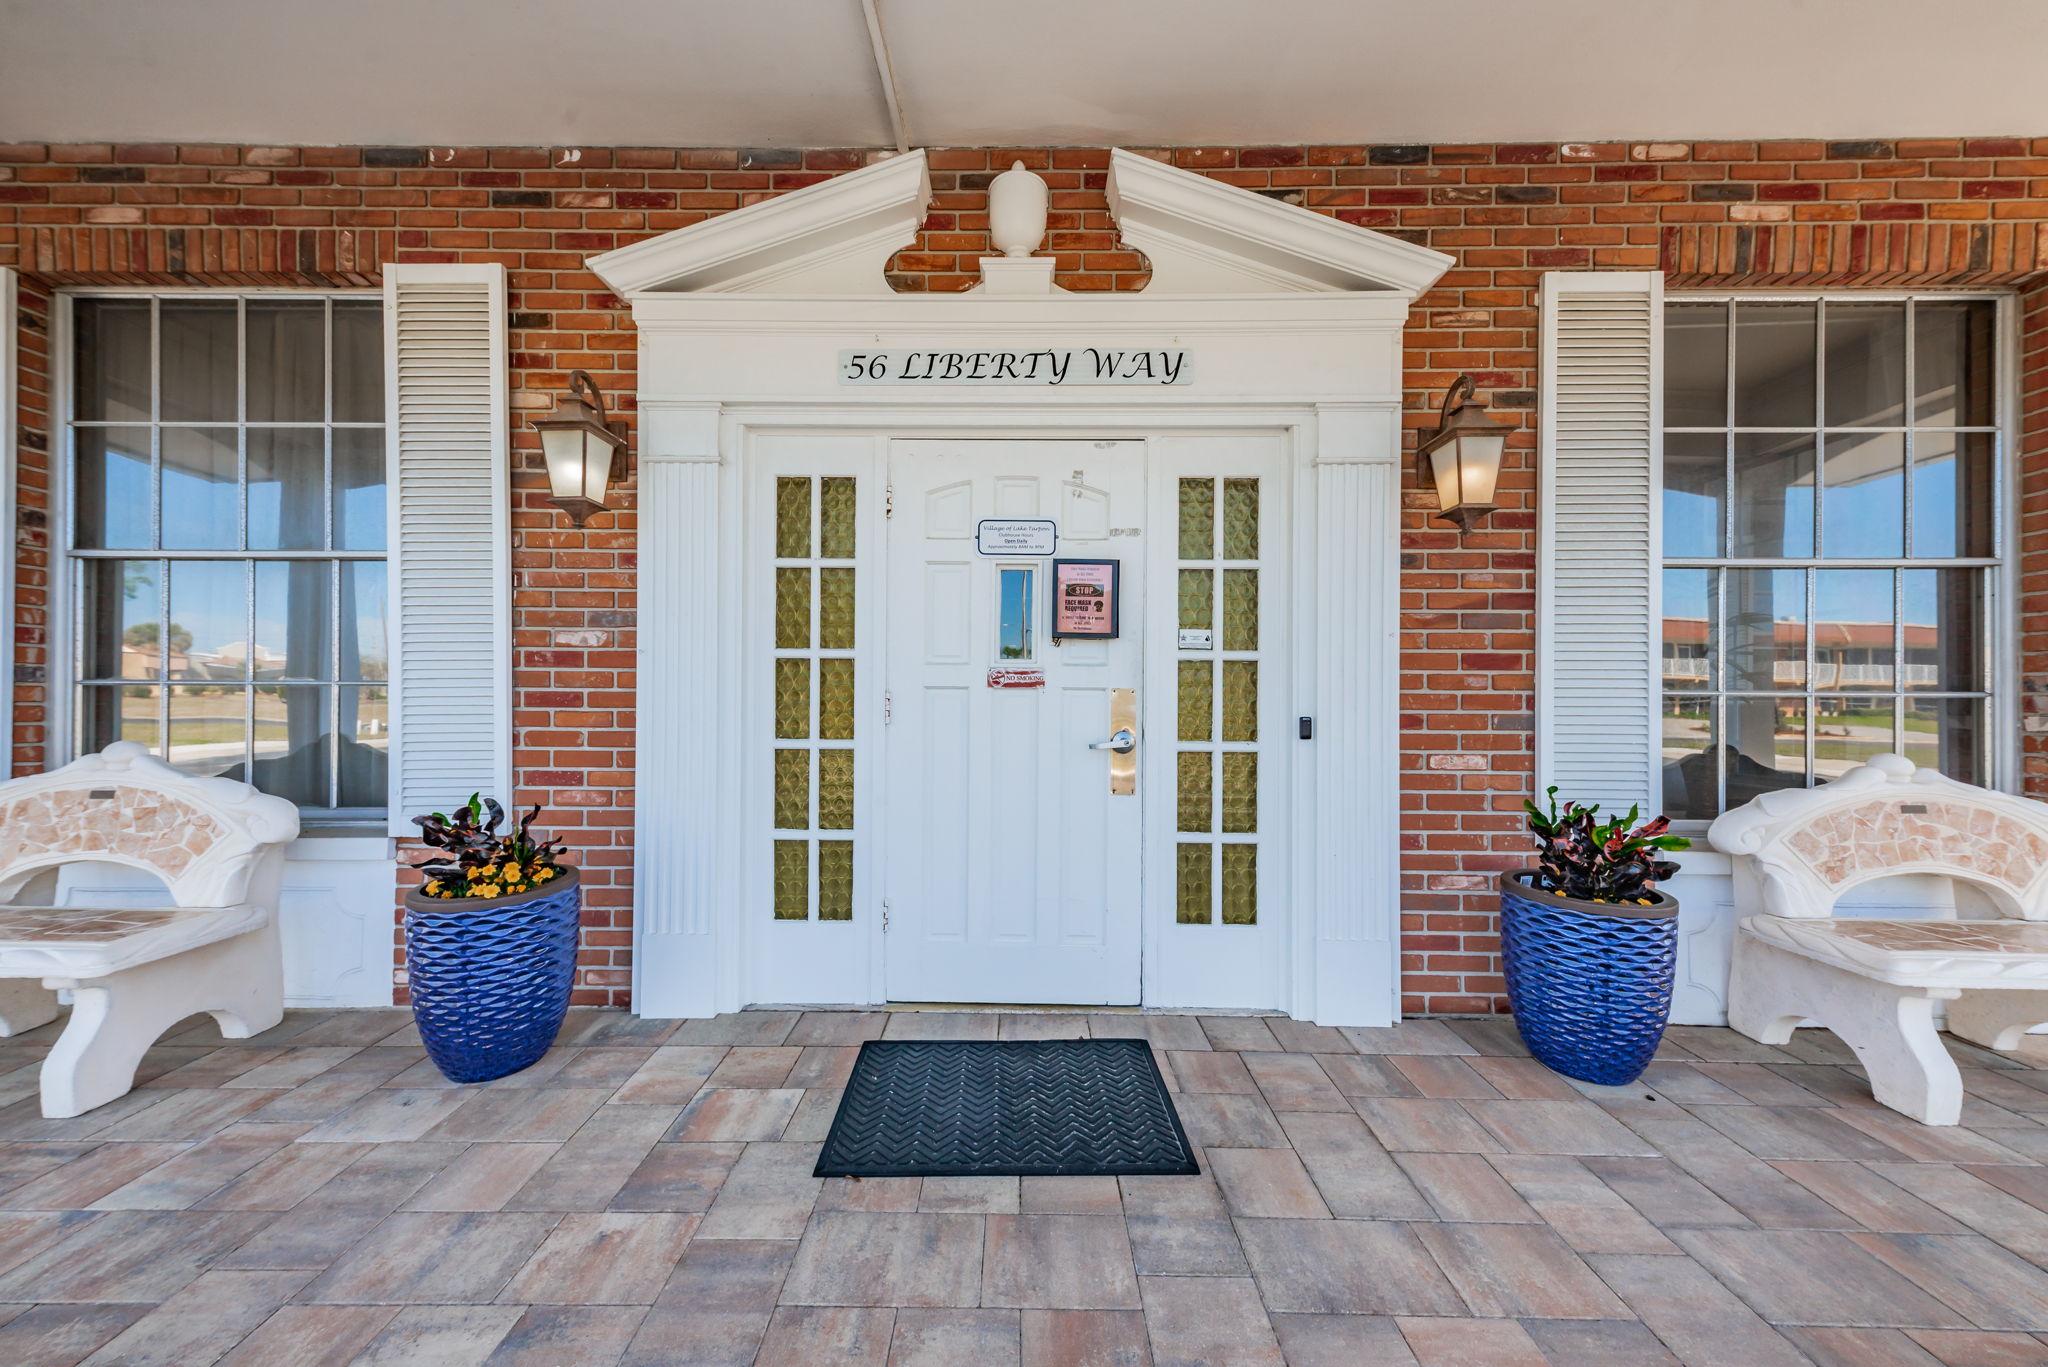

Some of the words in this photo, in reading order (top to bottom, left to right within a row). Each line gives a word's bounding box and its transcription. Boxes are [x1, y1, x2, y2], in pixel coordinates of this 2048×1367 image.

[848, 355, 887, 380] 56
[898, 349, 1072, 385] LIBERTY
[1083, 348, 1184, 385] WAY
[1075, 586, 1094, 594] STOP
